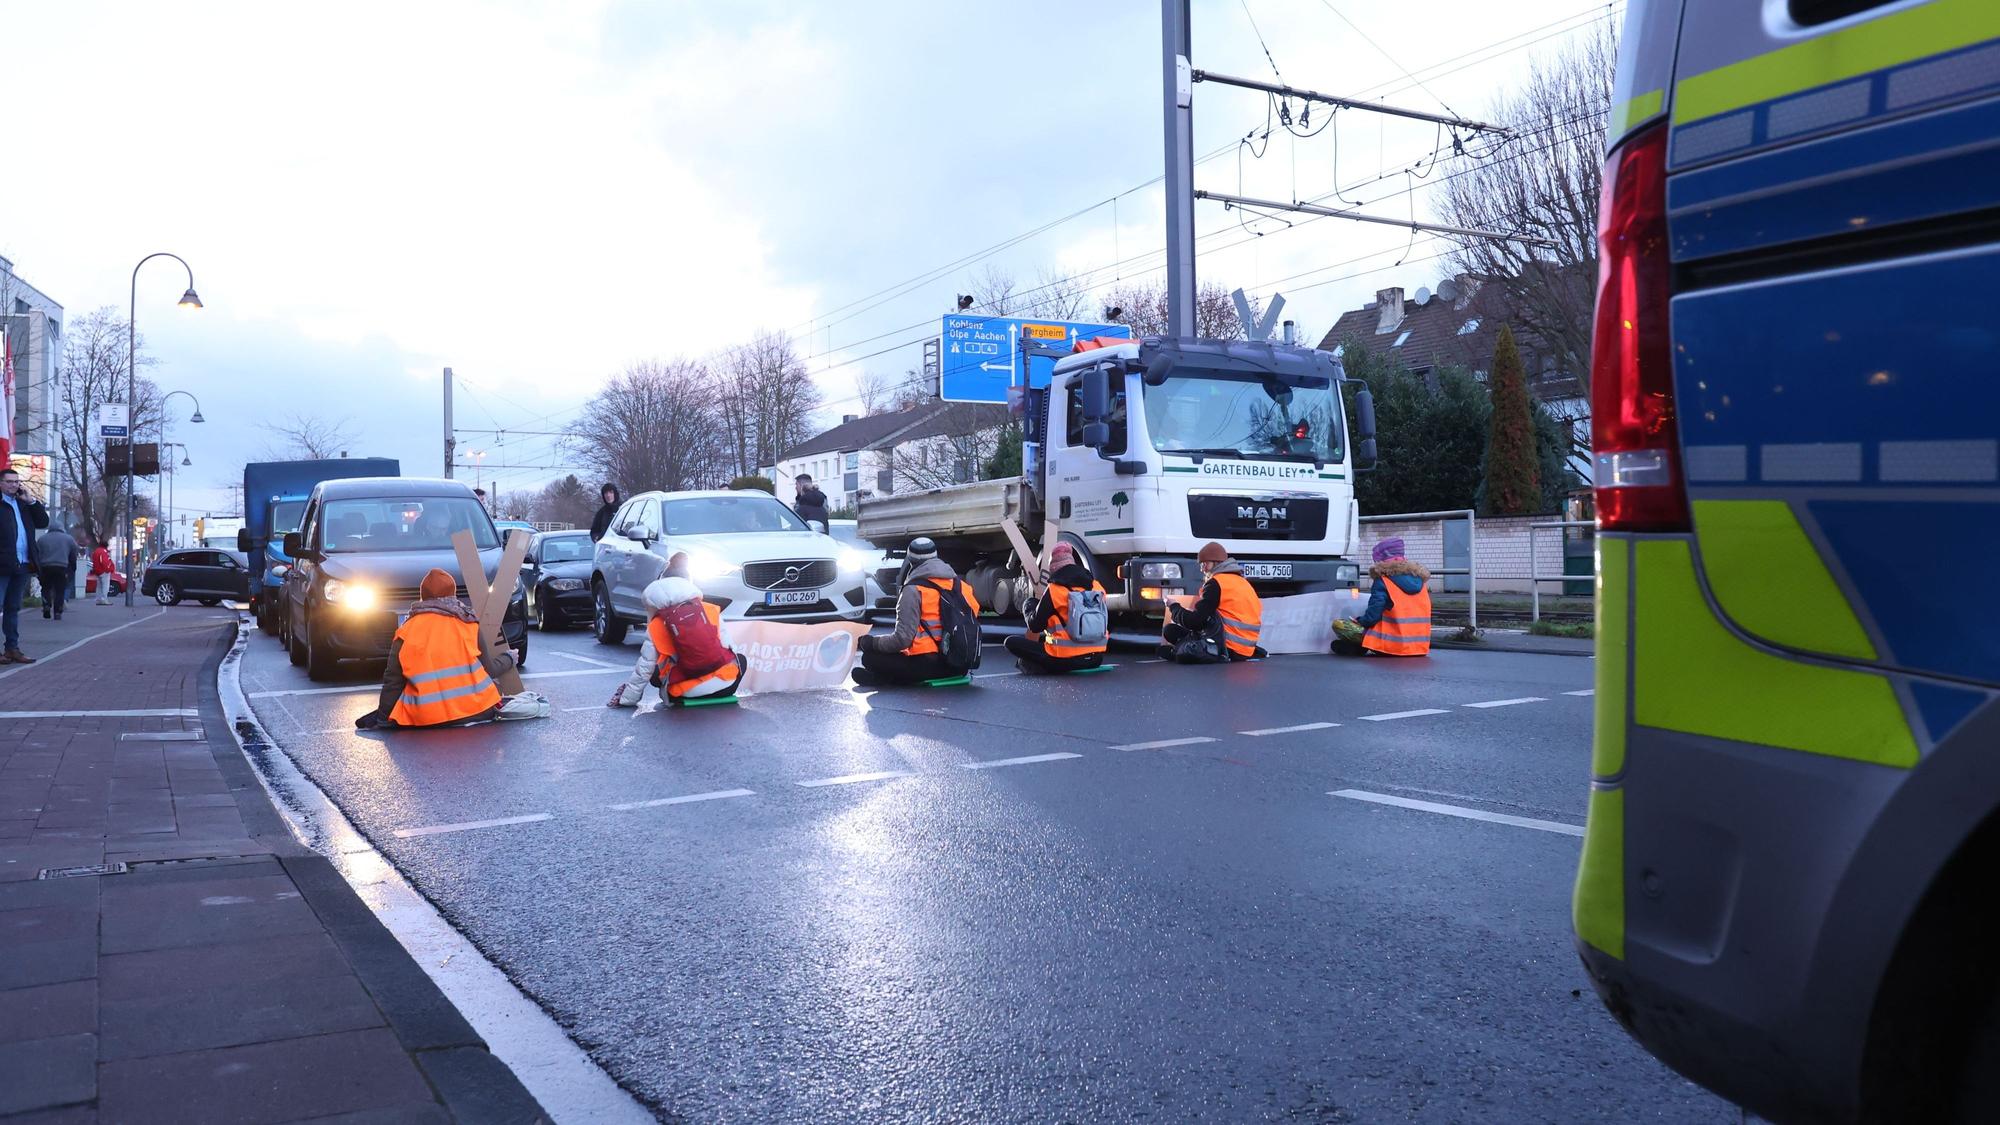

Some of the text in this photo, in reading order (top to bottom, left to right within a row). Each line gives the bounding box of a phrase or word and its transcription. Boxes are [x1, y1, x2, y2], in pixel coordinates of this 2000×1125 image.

[950, 319, 984, 330] Koblenz
[950, 329, 1006, 341] Olpe Aachen
[1029, 327, 1064, 338] ergheim
[1203, 463, 1298, 478] GARTENBAU LEY
[1237, 506, 1287, 519] MAN
[1272, 565, 1291, 577] 7500
[799, 592, 816, 602] 269
